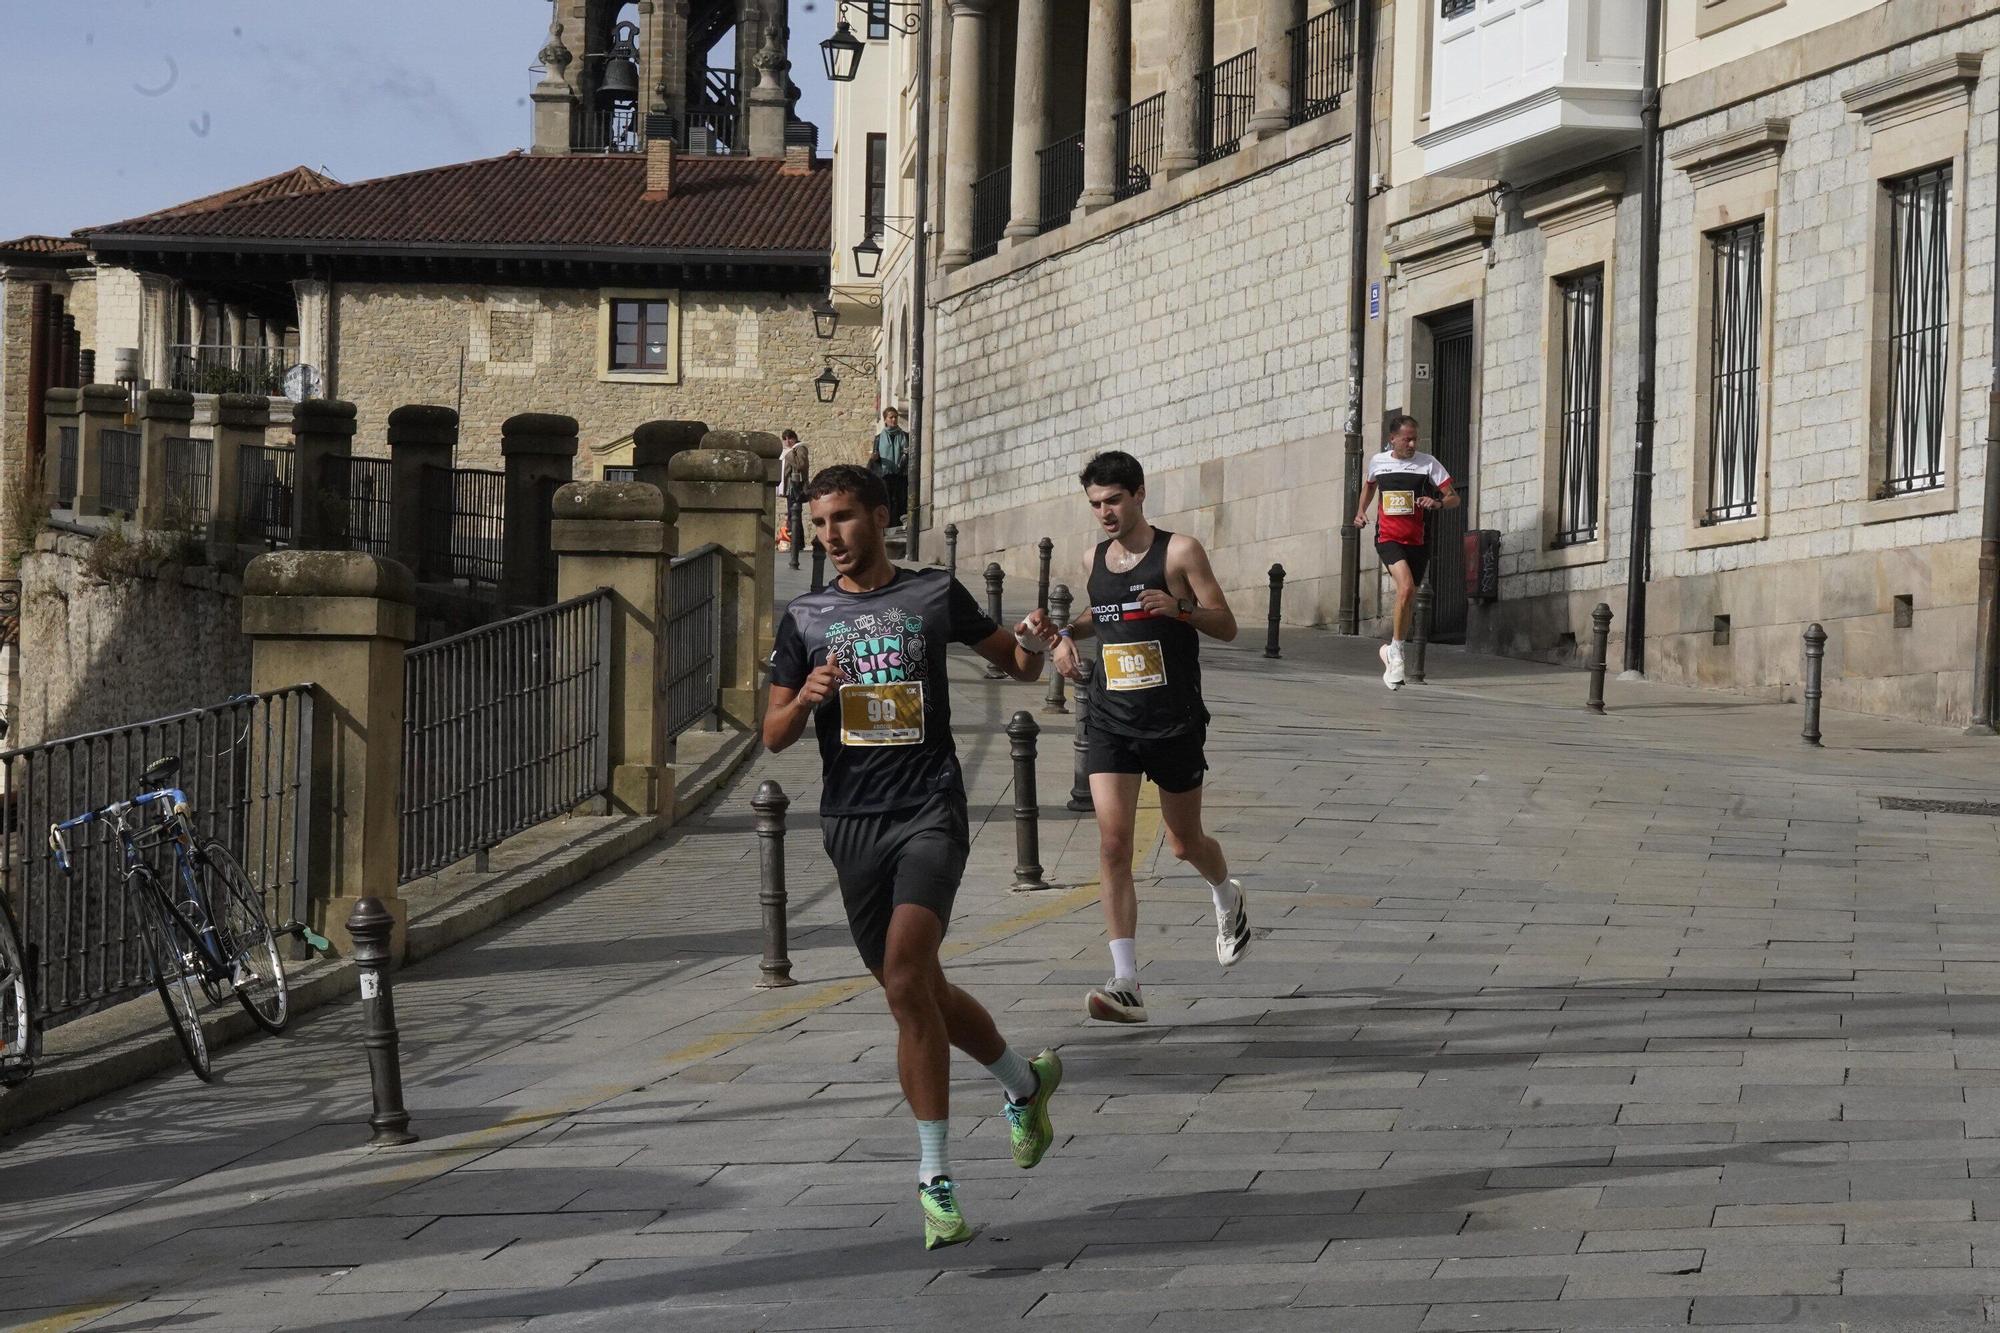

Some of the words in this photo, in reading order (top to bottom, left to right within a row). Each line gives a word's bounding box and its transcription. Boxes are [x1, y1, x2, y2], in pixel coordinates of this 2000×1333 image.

[1390, 496, 1405, 506] 223
[854, 636, 900, 657] RUN
[1118, 655, 1146, 673] 169
[862, 666, 905, 684] RUN
[867, 698, 896, 722] 99
